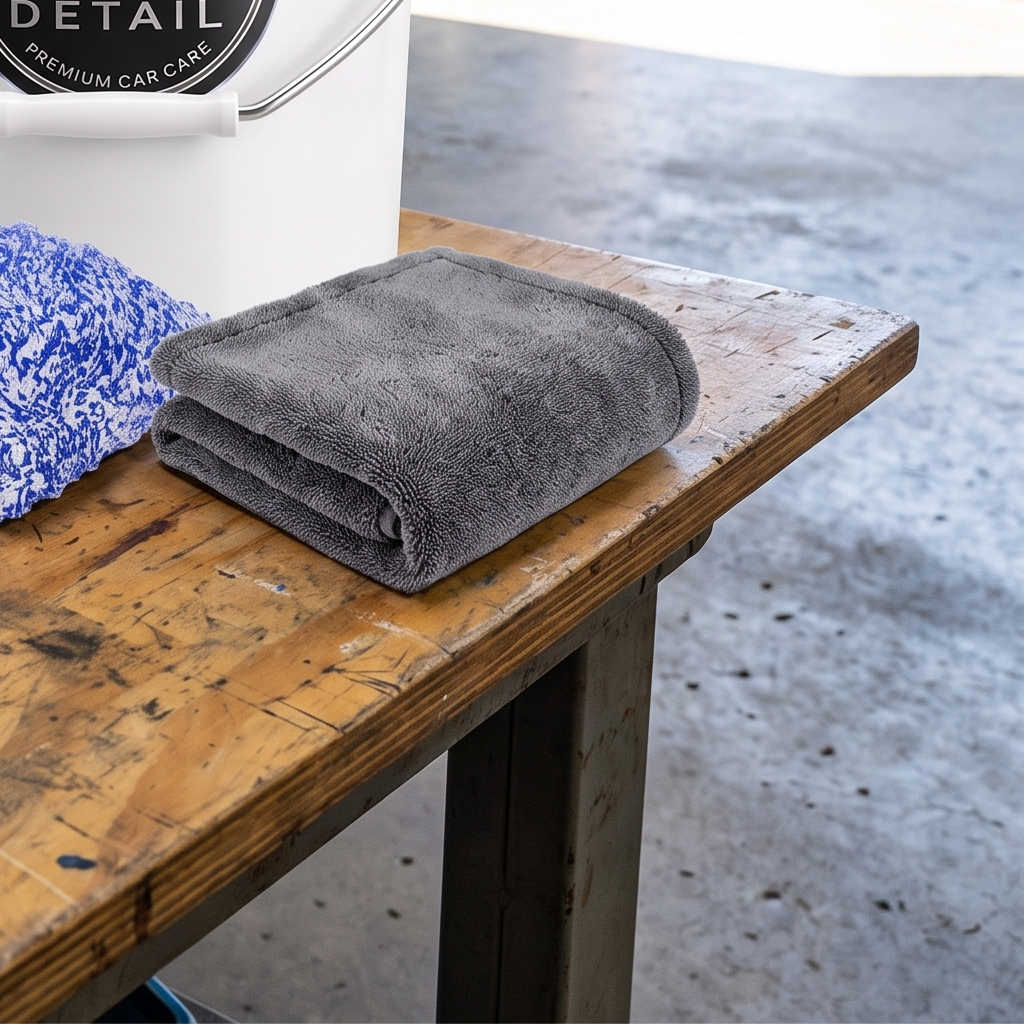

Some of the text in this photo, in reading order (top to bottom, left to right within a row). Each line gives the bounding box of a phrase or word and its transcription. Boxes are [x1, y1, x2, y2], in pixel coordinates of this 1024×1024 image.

[25, 40, 212, 89] PREMIUM CAR CARE
